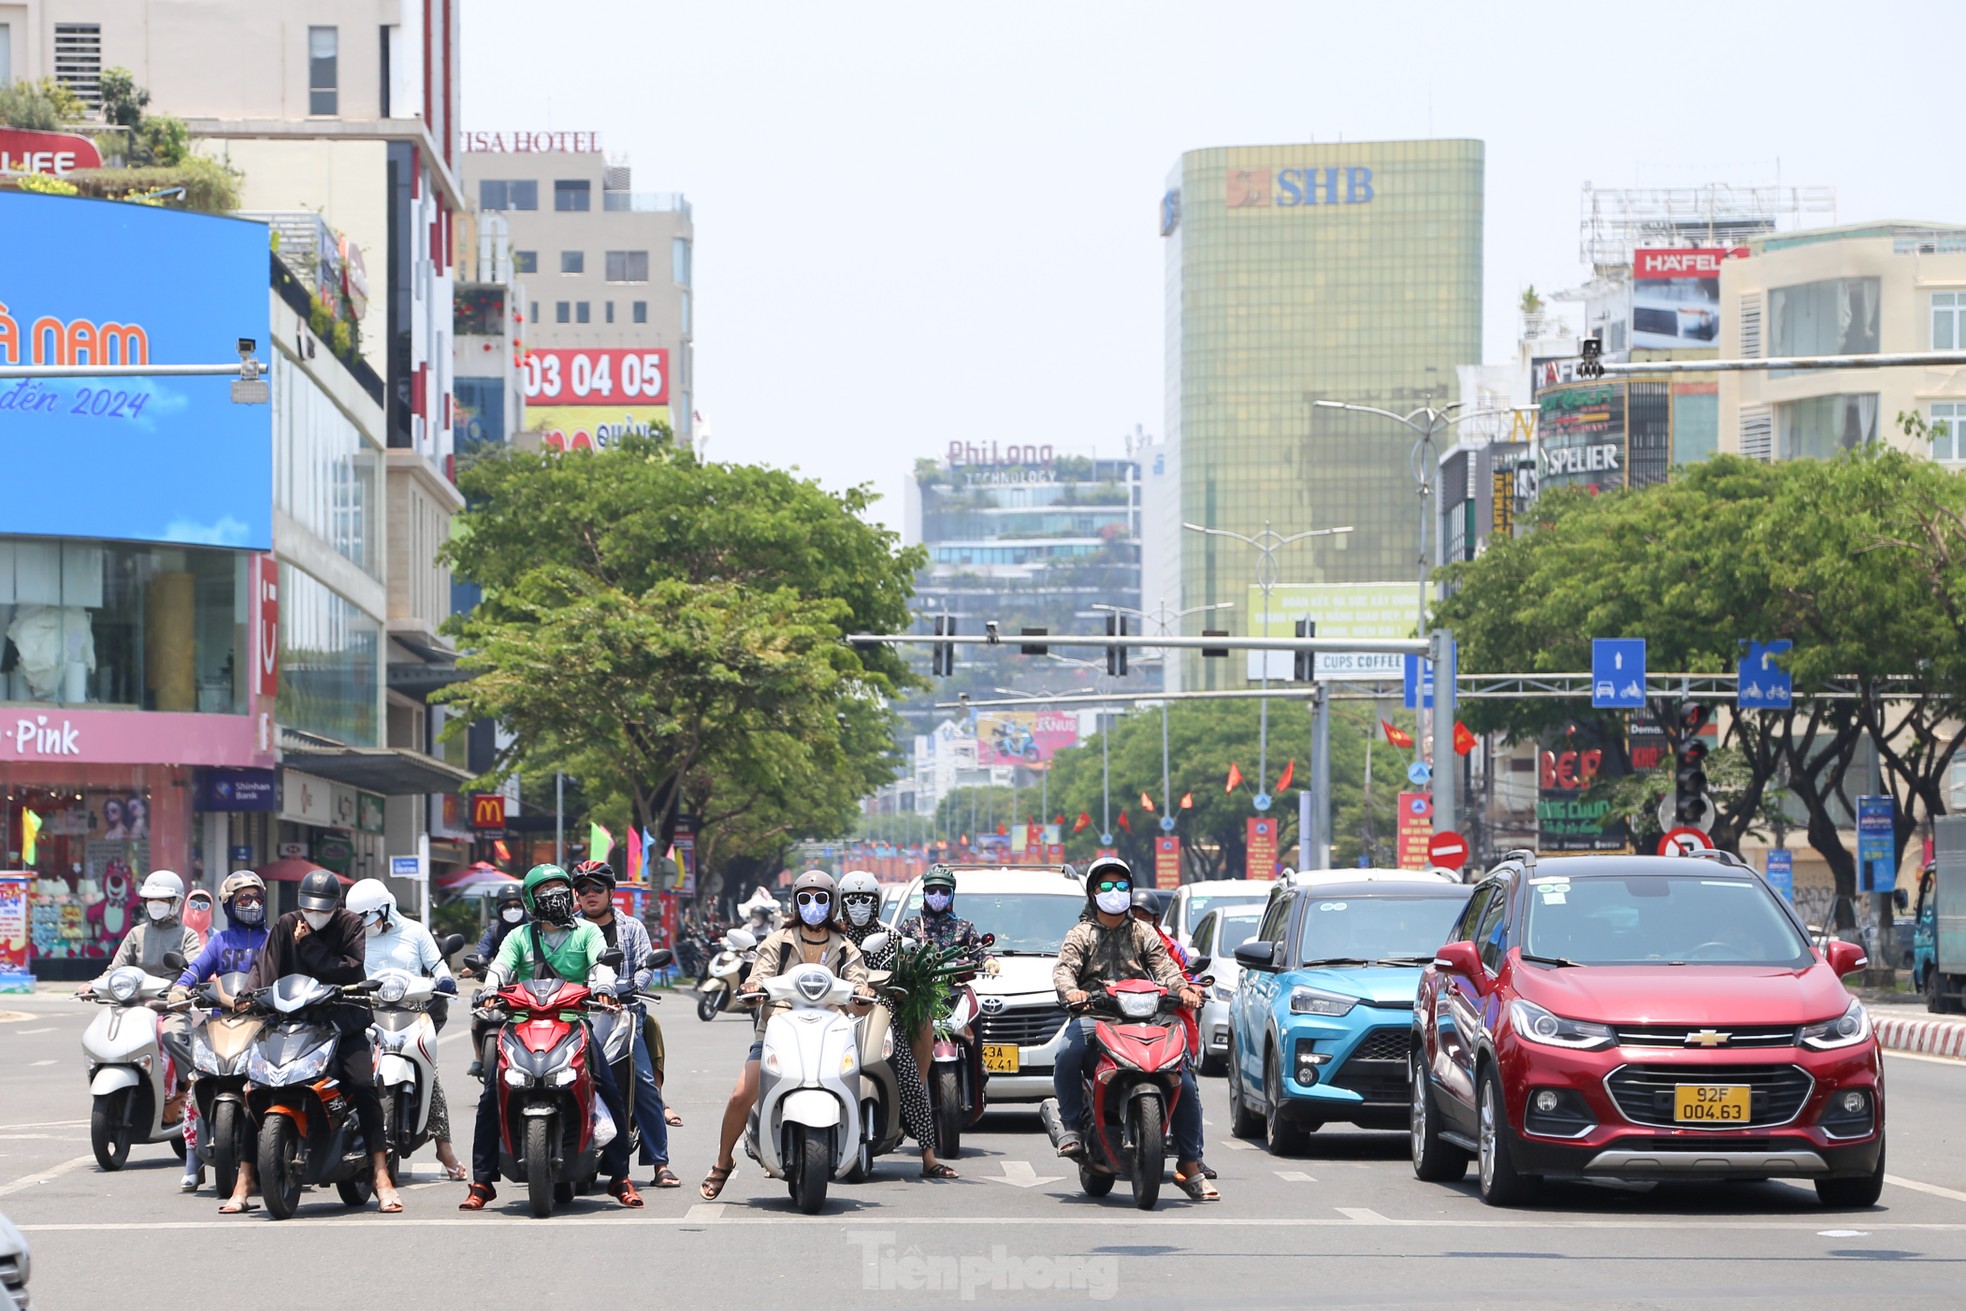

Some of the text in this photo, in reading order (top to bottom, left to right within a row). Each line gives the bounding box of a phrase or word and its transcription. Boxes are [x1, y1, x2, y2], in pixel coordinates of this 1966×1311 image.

[460, 131, 602, 153] ISA HOTEL
[1, 151, 76, 176] LIFE
[1275, 165, 1375, 207] SHB
[1645, 254, 1721, 272] HÄFEL
[32, 315, 149, 366] NAM
[524, 353, 663, 397] 03 04 05
[70, 387, 150, 419] 2024
[1323, 654, 1401, 668] CUPS COFFEE
[16, 715, 80, 755] Pink
[235, 782, 271, 791] Shinhan
[235, 792, 258, 800] Bank
[985, 1059, 1012, 1071] 4.41
[1697, 1087, 1729, 1103] 92F
[1683, 1104, 1742, 1120] 004.63
